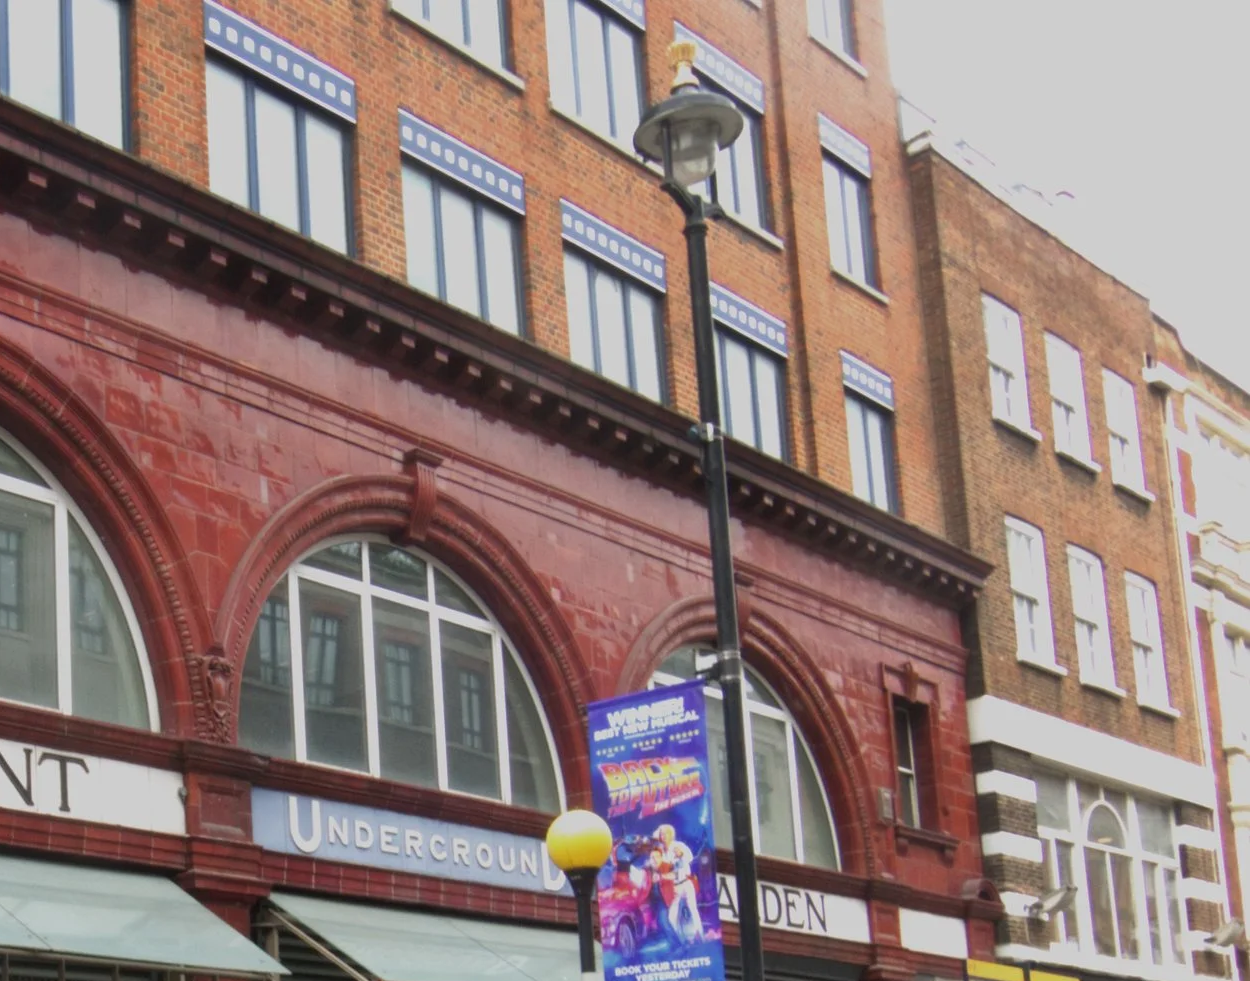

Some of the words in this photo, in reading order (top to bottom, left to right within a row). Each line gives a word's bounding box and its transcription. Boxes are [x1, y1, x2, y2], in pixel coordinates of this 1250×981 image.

[598, 757, 673, 791] BACK
[615, 965, 641, 976] BOOK
[643, 961, 670, 973] YOUR
[672, 956, 711, 968] TICKETS
